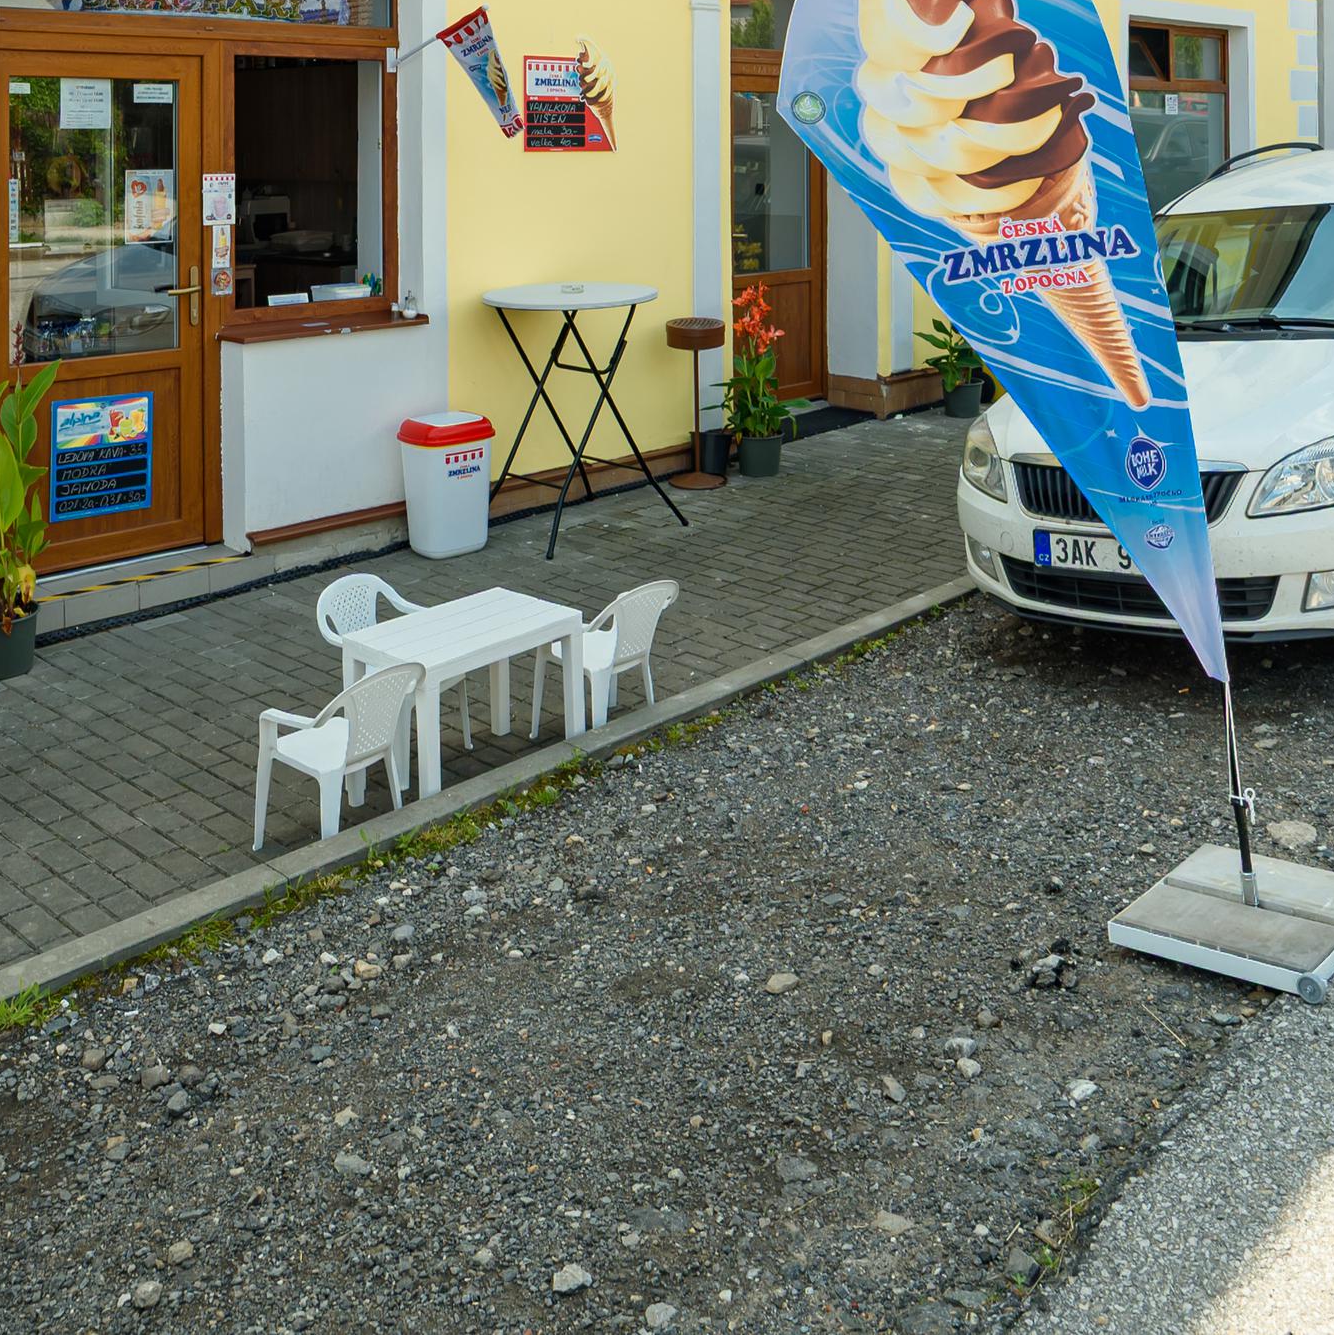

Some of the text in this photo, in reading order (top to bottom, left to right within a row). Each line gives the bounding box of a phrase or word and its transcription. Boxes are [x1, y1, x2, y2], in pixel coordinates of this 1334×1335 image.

[535, 78, 577, 87] ZMRZLINA
[1001, 216, 1064, 239] ČESKÁ
[943, 228, 1138, 282] ZMRZLINA
[1002, 269, 1089, 295] Z OPOČNA
[60, 478, 117, 495] JAHODA
[1039, 553, 1050, 562] CZ
[1055, 537, 1098, 567] 3AK
